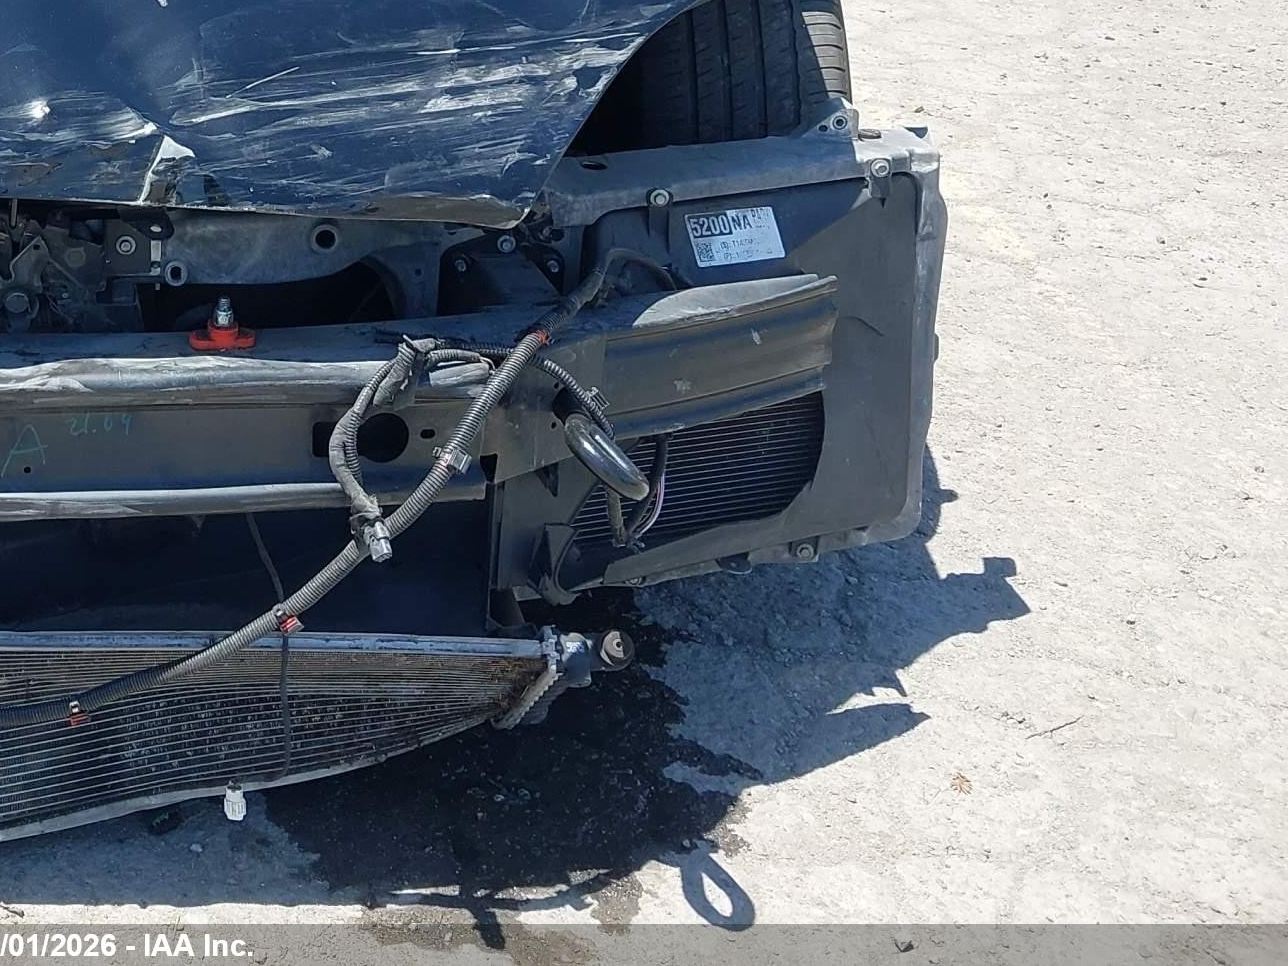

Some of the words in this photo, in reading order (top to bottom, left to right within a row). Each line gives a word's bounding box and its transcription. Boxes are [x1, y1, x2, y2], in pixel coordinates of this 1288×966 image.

[690, 214, 730, 237] 5200
[731, 213, 752, 231] NA
[0, 423, 48, 478] A
